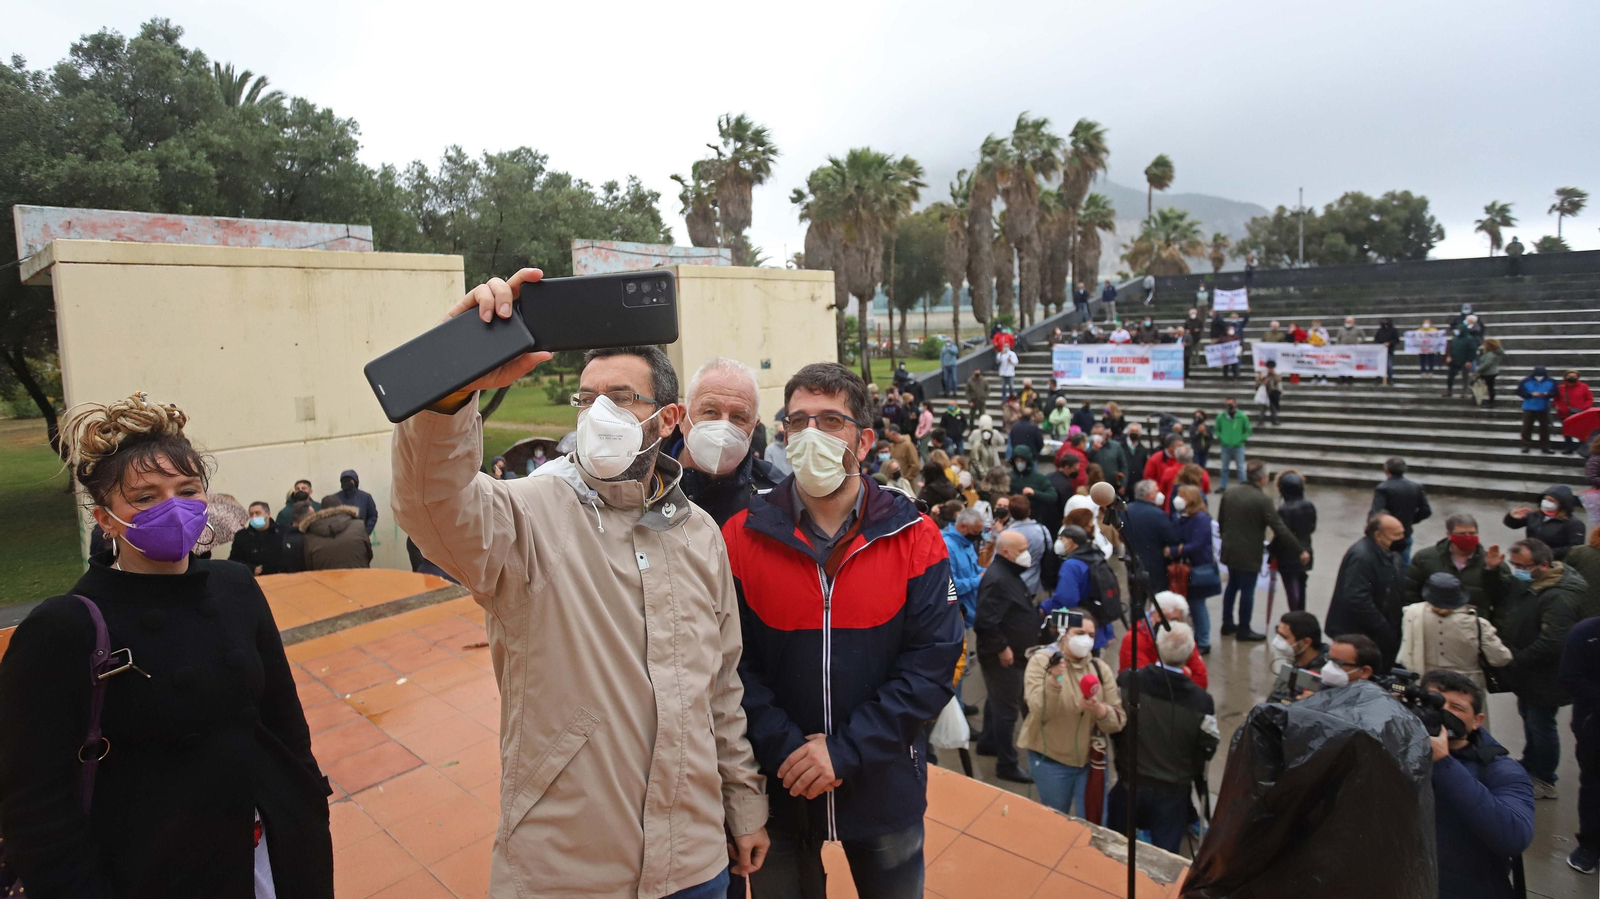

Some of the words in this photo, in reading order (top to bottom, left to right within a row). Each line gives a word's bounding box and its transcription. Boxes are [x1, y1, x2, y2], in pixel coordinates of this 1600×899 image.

[1053, 370, 1065, 378] NO
[1117, 366, 1136, 374] CABLE
[1152, 371, 1165, 380] NO
